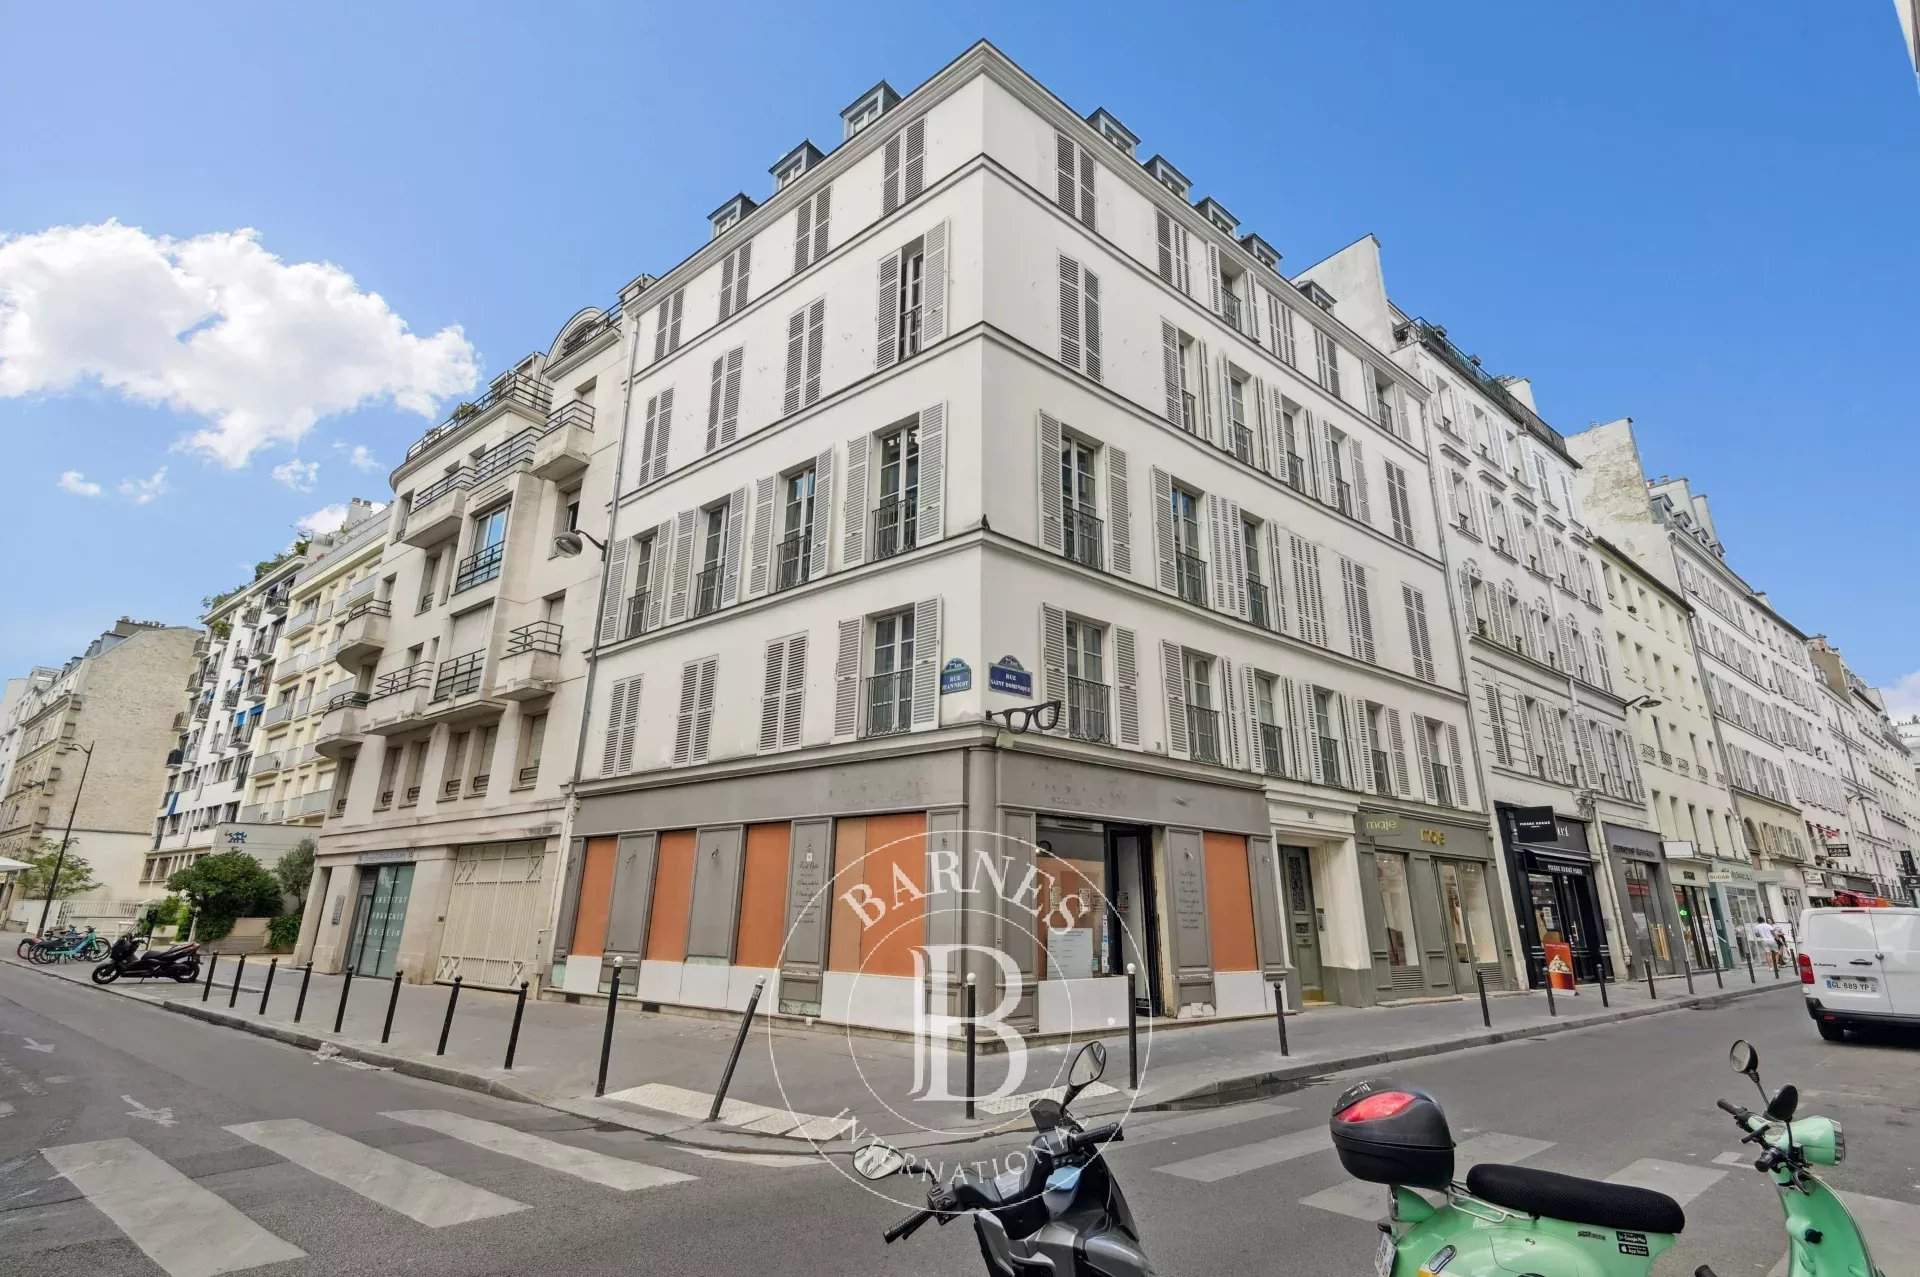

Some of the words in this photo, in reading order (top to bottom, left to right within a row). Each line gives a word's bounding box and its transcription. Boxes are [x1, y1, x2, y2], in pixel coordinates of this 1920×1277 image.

[1005, 673, 1017, 681] RUE
[990, 679, 1005, 687] SAINT
[1005, 682, 1031, 692] DOMINIQUE
[1366, 817, 1398, 831] maje
[1419, 828, 1446, 846] maje
